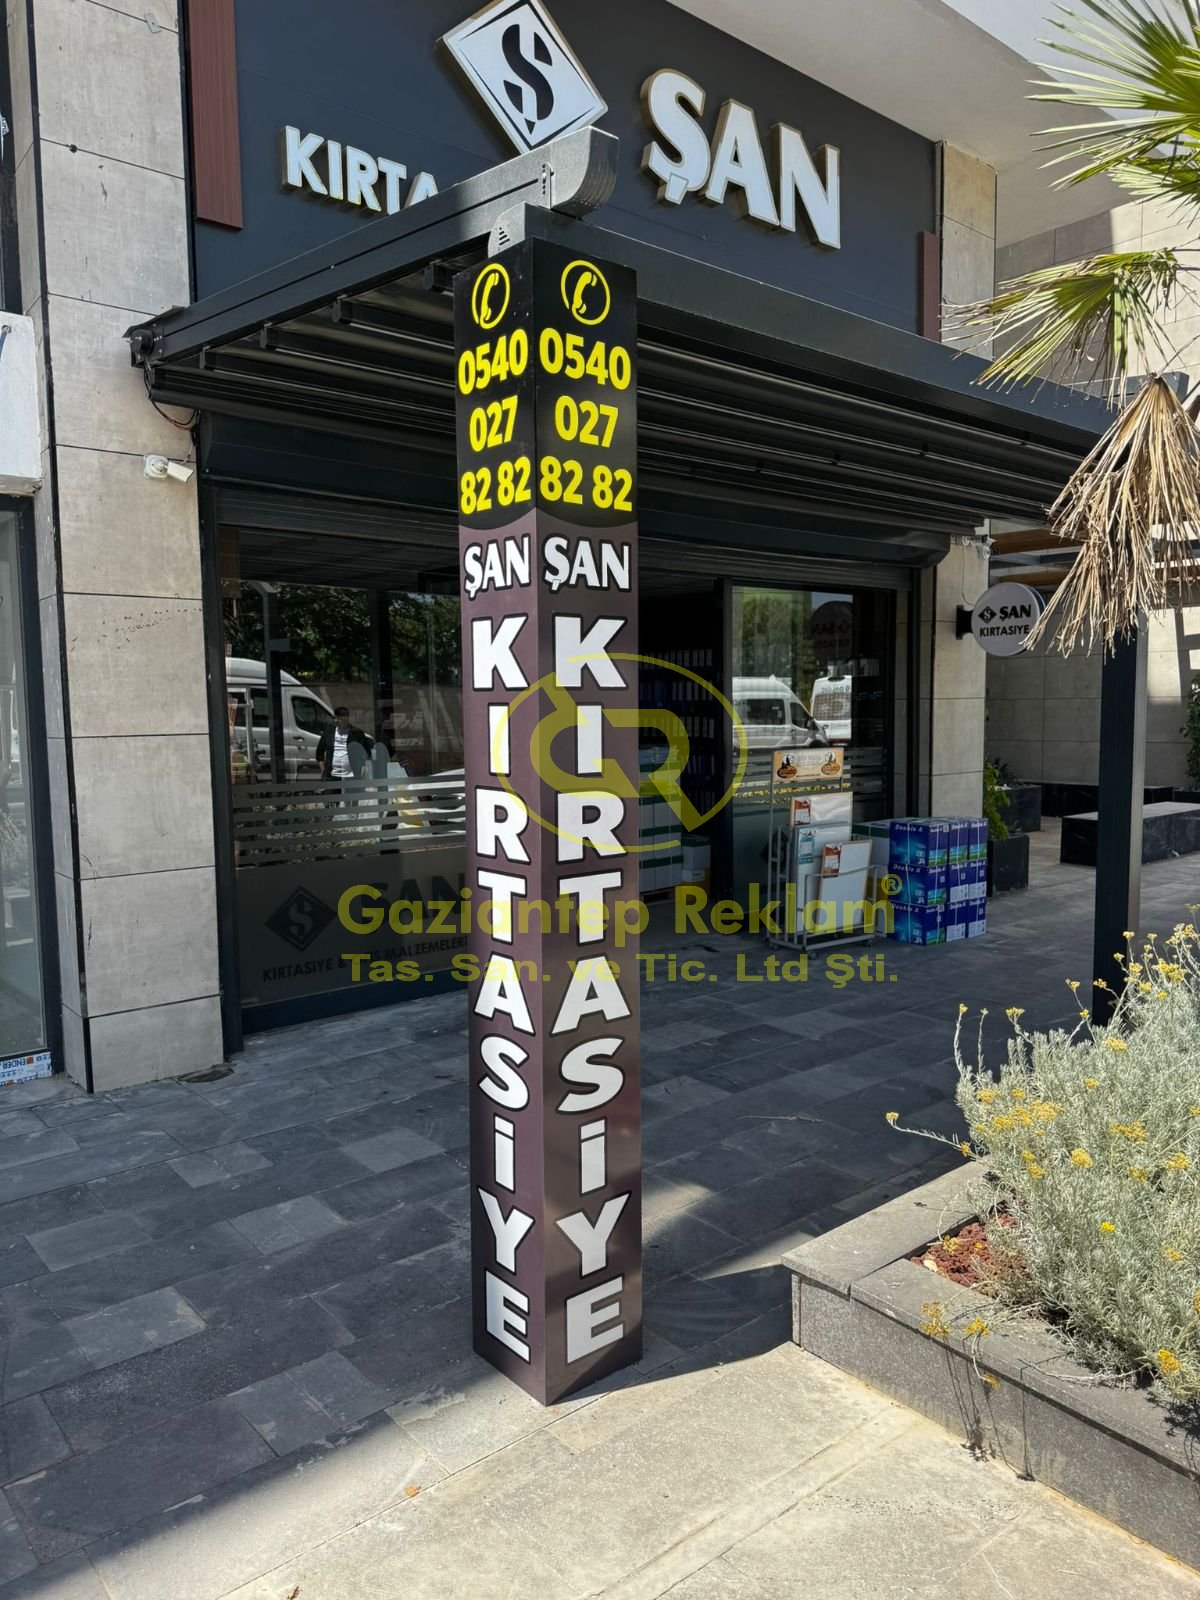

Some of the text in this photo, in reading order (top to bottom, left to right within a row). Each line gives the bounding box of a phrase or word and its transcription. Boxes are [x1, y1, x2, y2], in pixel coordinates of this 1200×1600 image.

[642, 70, 841, 249] ŞAN
[457, 328, 529, 395] 0540
[539, 327, 631, 390] 0540
[469, 395, 519, 452] 027
[554, 395, 619, 448] 027
[460, 456, 532, 515] 82 82
[540, 455, 632, 512] 82 82
[463, 536, 530, 598] ŞAN
[544, 536, 630, 592] ŞAN
[999, 604, 1032, 621] ŞAN
